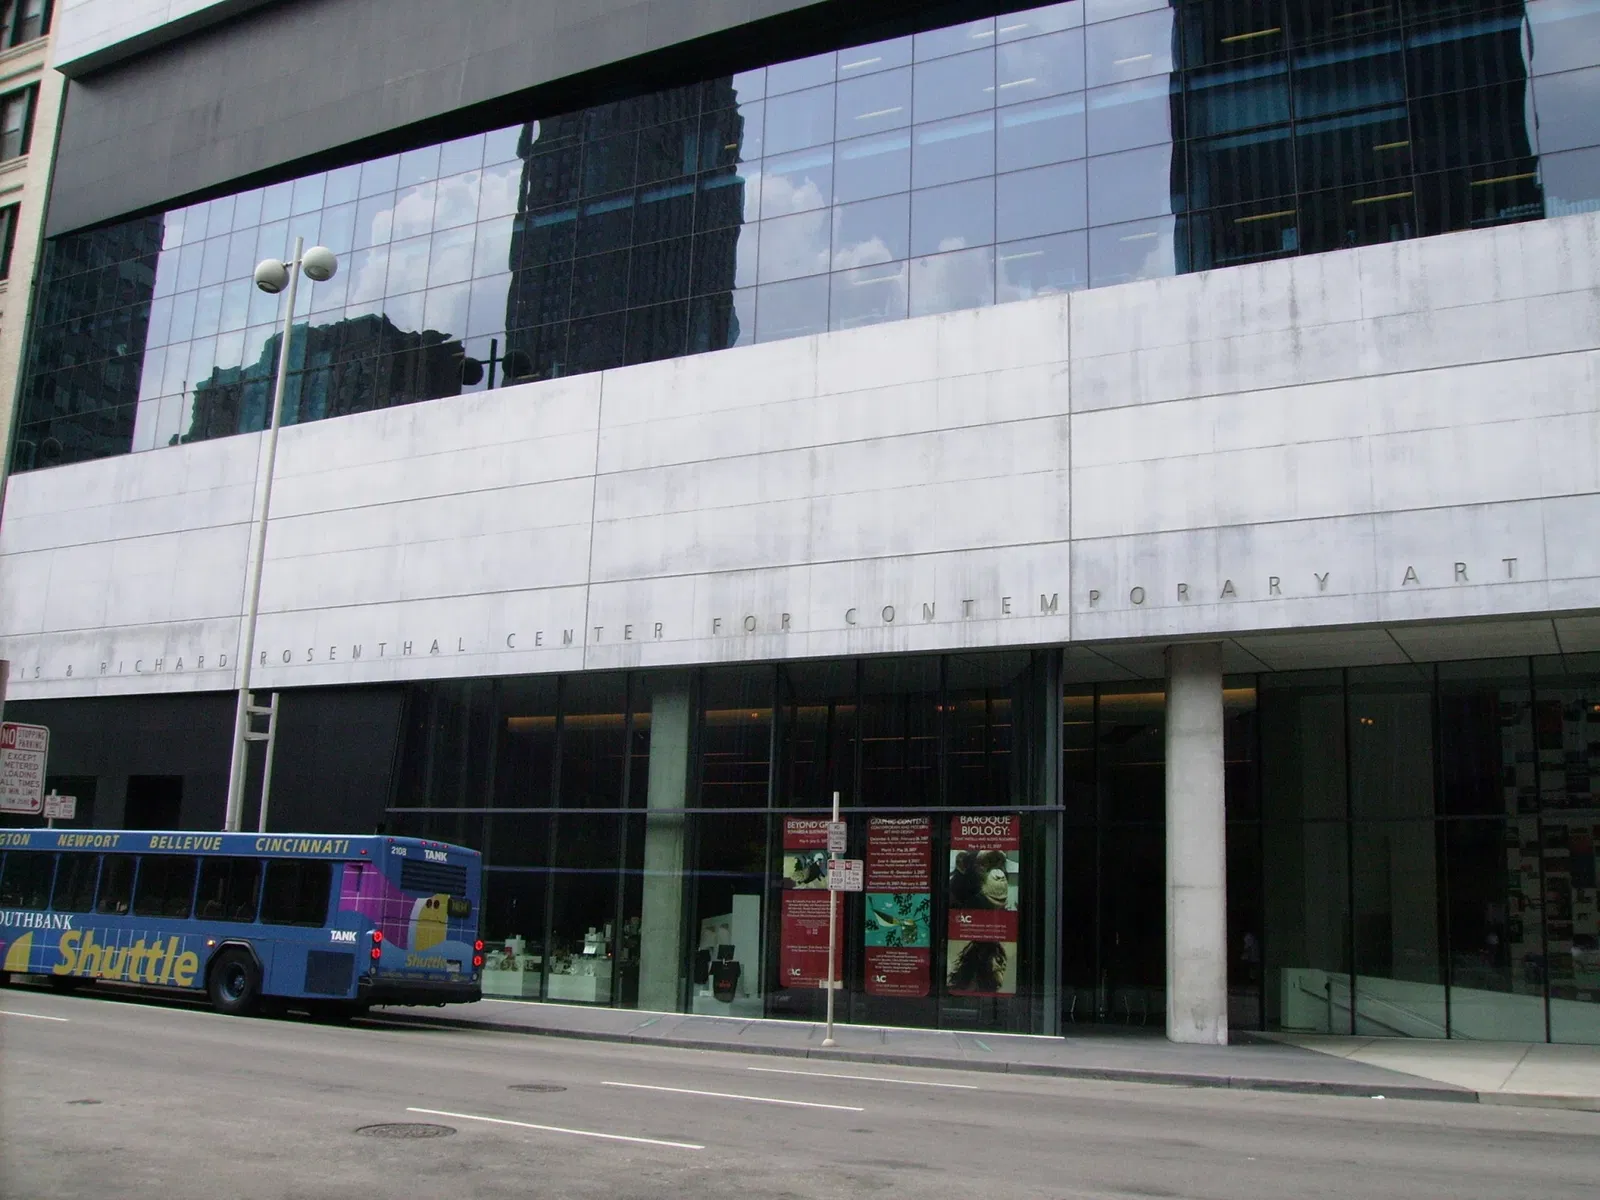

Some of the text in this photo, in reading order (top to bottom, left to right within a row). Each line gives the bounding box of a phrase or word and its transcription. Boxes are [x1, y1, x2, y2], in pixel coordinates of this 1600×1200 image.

[100, 653, 228, 676] RICHARD
[260, 637, 466, 665] ROSENTHAL
[506, 622, 664, 648] CENTER
[712, 612, 791, 635] FOR
[845, 572, 1330, 625] CONTEMPORARY
[1402, 557, 1518, 586] ART
[1, 727, 16, 745] NO
[7, 752, 37, 762] EXCEPT
[4, 761, 39, 771] METERED
[4, 770, 37, 779] LOADING
[19, 779, 40, 788] TIMES
[787, 821, 817, 829] BEYOND
[960, 815, 1011, 825] BAROQUE
[961, 826, 1011, 836] BIOLOGY:
[57, 833, 120, 848] NEWPORT
[149, 835, 222, 851] BELLEVUE
[255, 837, 350, 855] CINCINNATI
[391, 846, 407, 856] 2108
[424, 849, 448, 862] TANK
[330, 930, 357, 942] TANK
[53, 929, 199, 987] Shuttle
